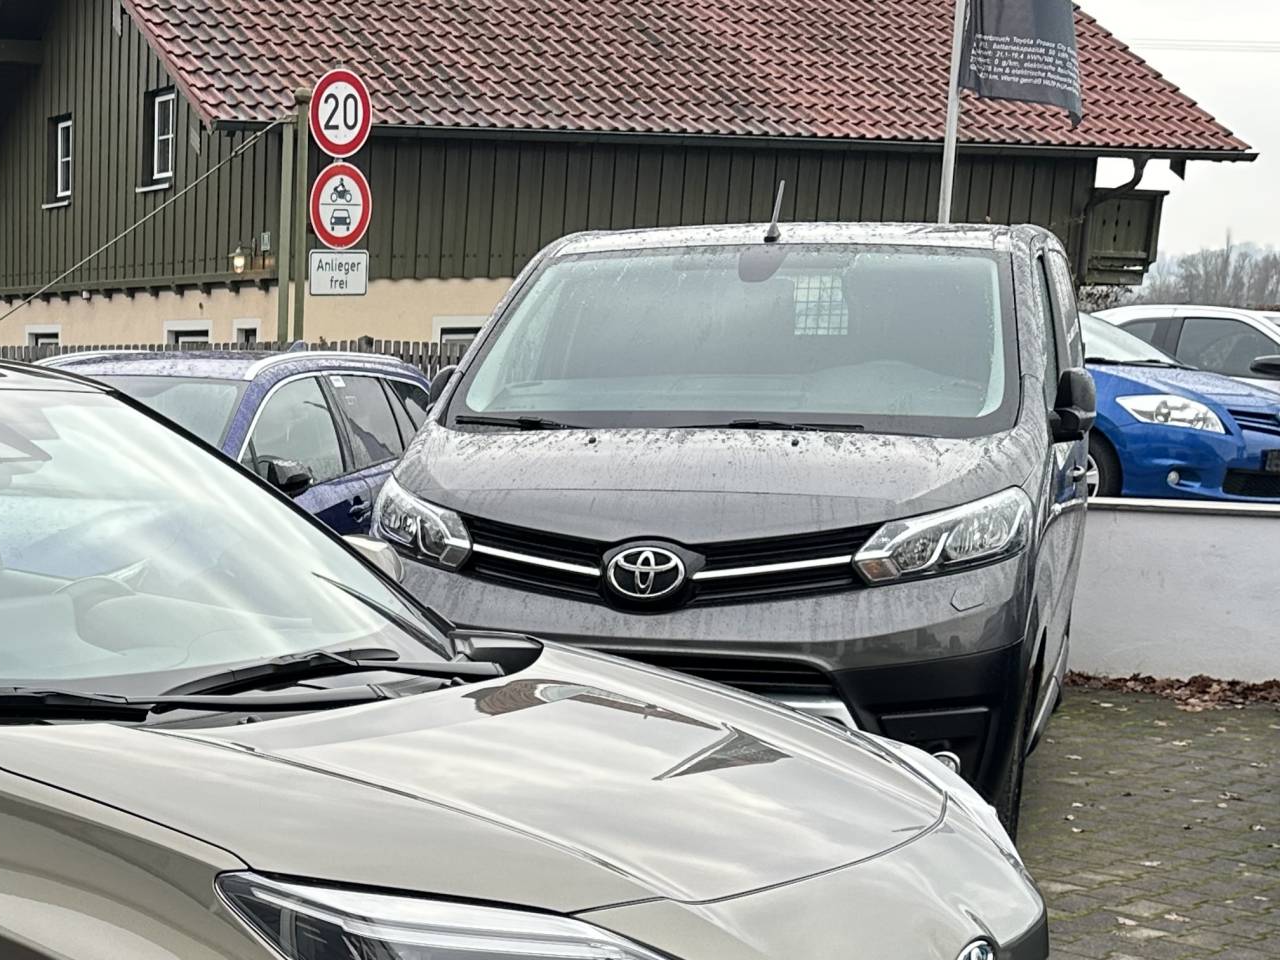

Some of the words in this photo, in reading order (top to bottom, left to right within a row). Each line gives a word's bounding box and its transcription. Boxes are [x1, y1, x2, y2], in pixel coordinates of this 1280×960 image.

[324, 92, 358, 131] 20
[316, 257, 361, 277] Anlieger
[329, 275, 348, 289] frei
